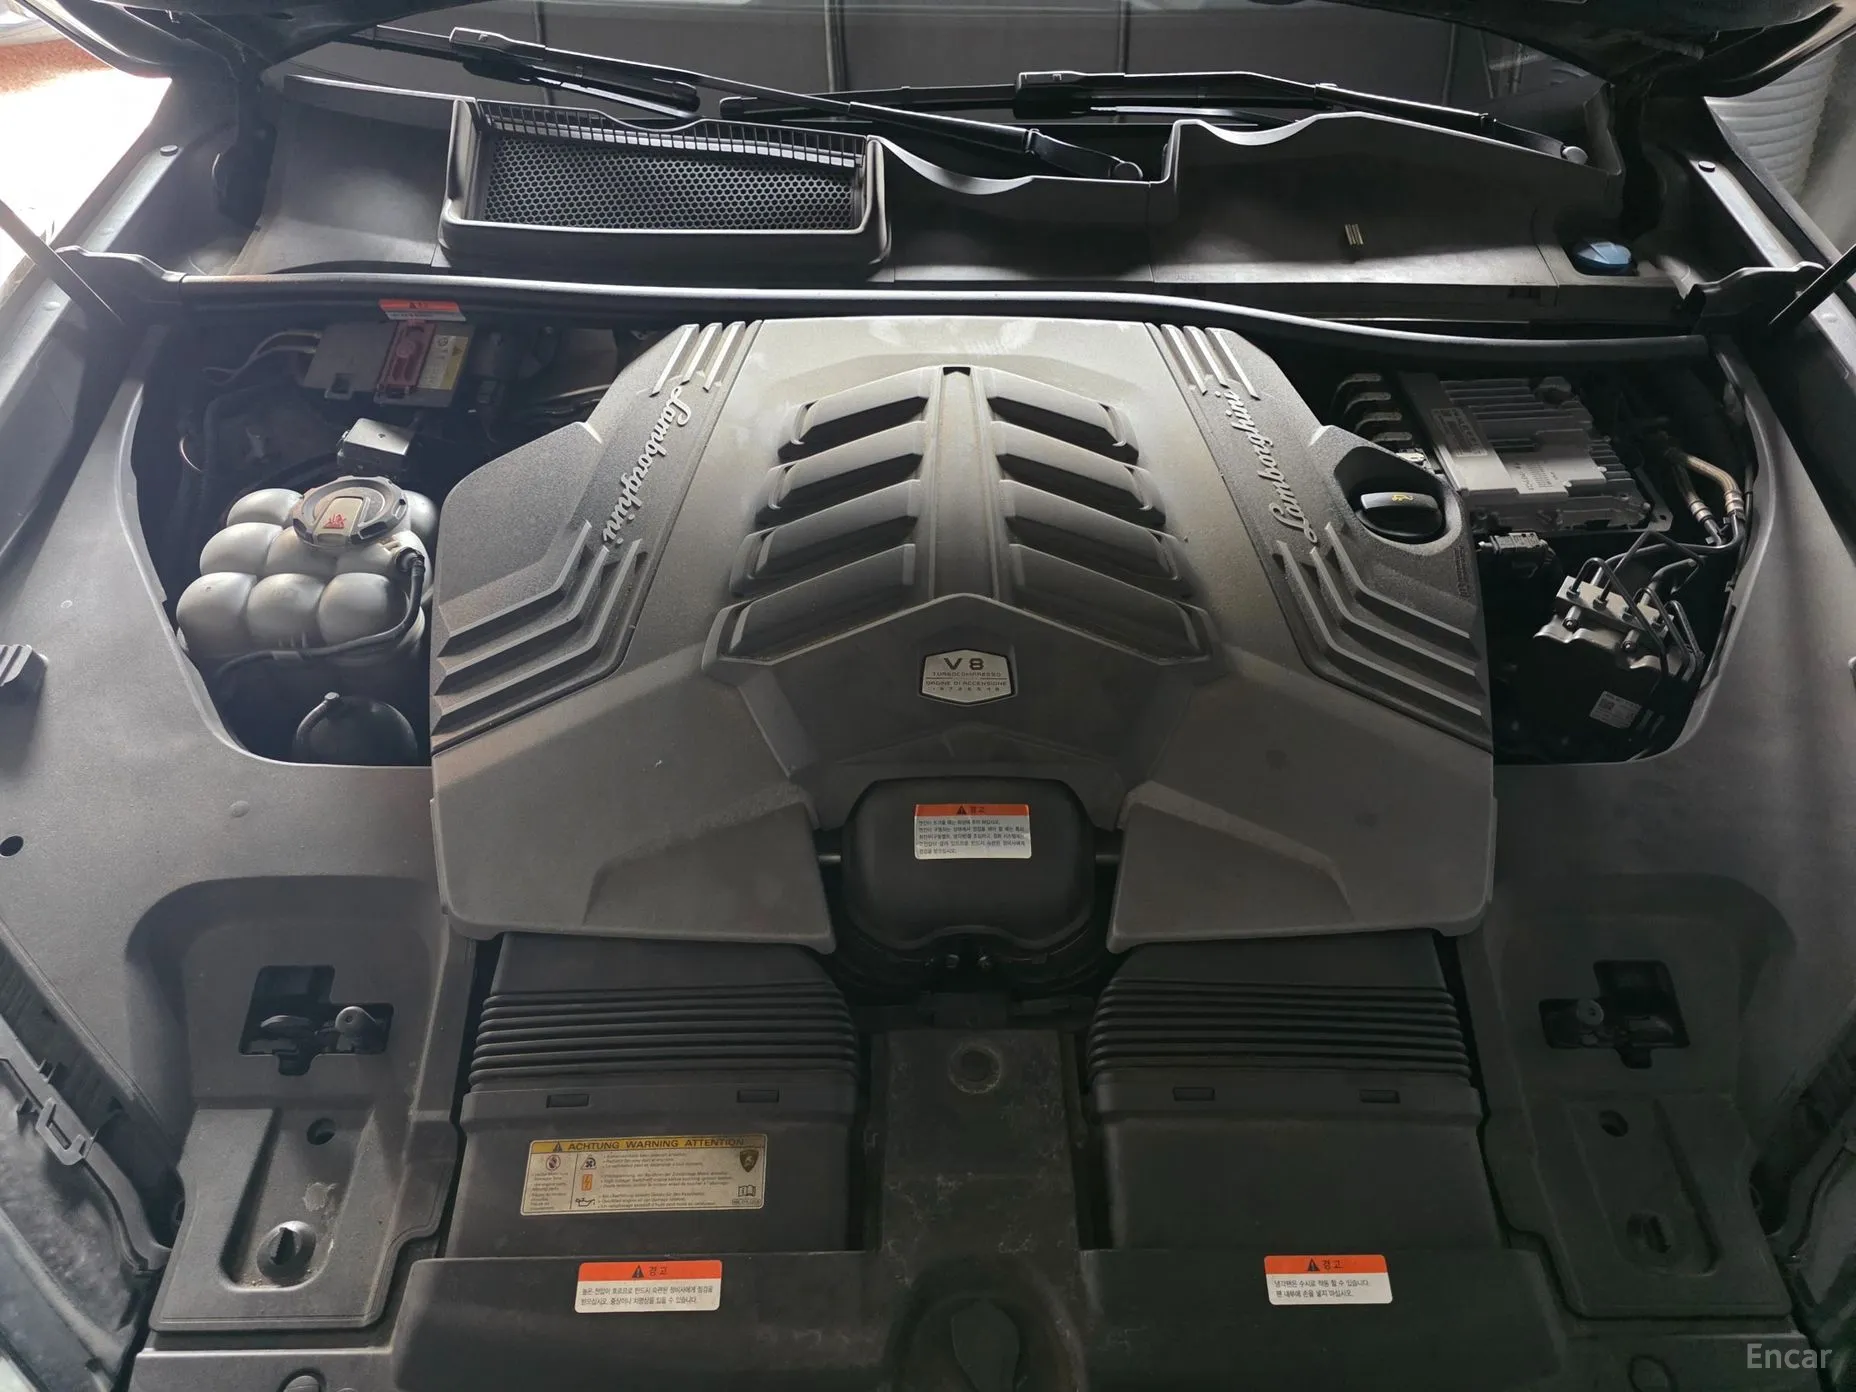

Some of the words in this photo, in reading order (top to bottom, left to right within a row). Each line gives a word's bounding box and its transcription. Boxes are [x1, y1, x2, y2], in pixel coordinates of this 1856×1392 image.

[603, 386, 691, 543] Lamborghini
[1215, 391, 1318, 543] Lamborghini
[567, 1141, 620, 1151] ACHTUNG
[625, 1139, 679, 1150] WARNING
[684, 1137, 745, 1148] ATTENTION
